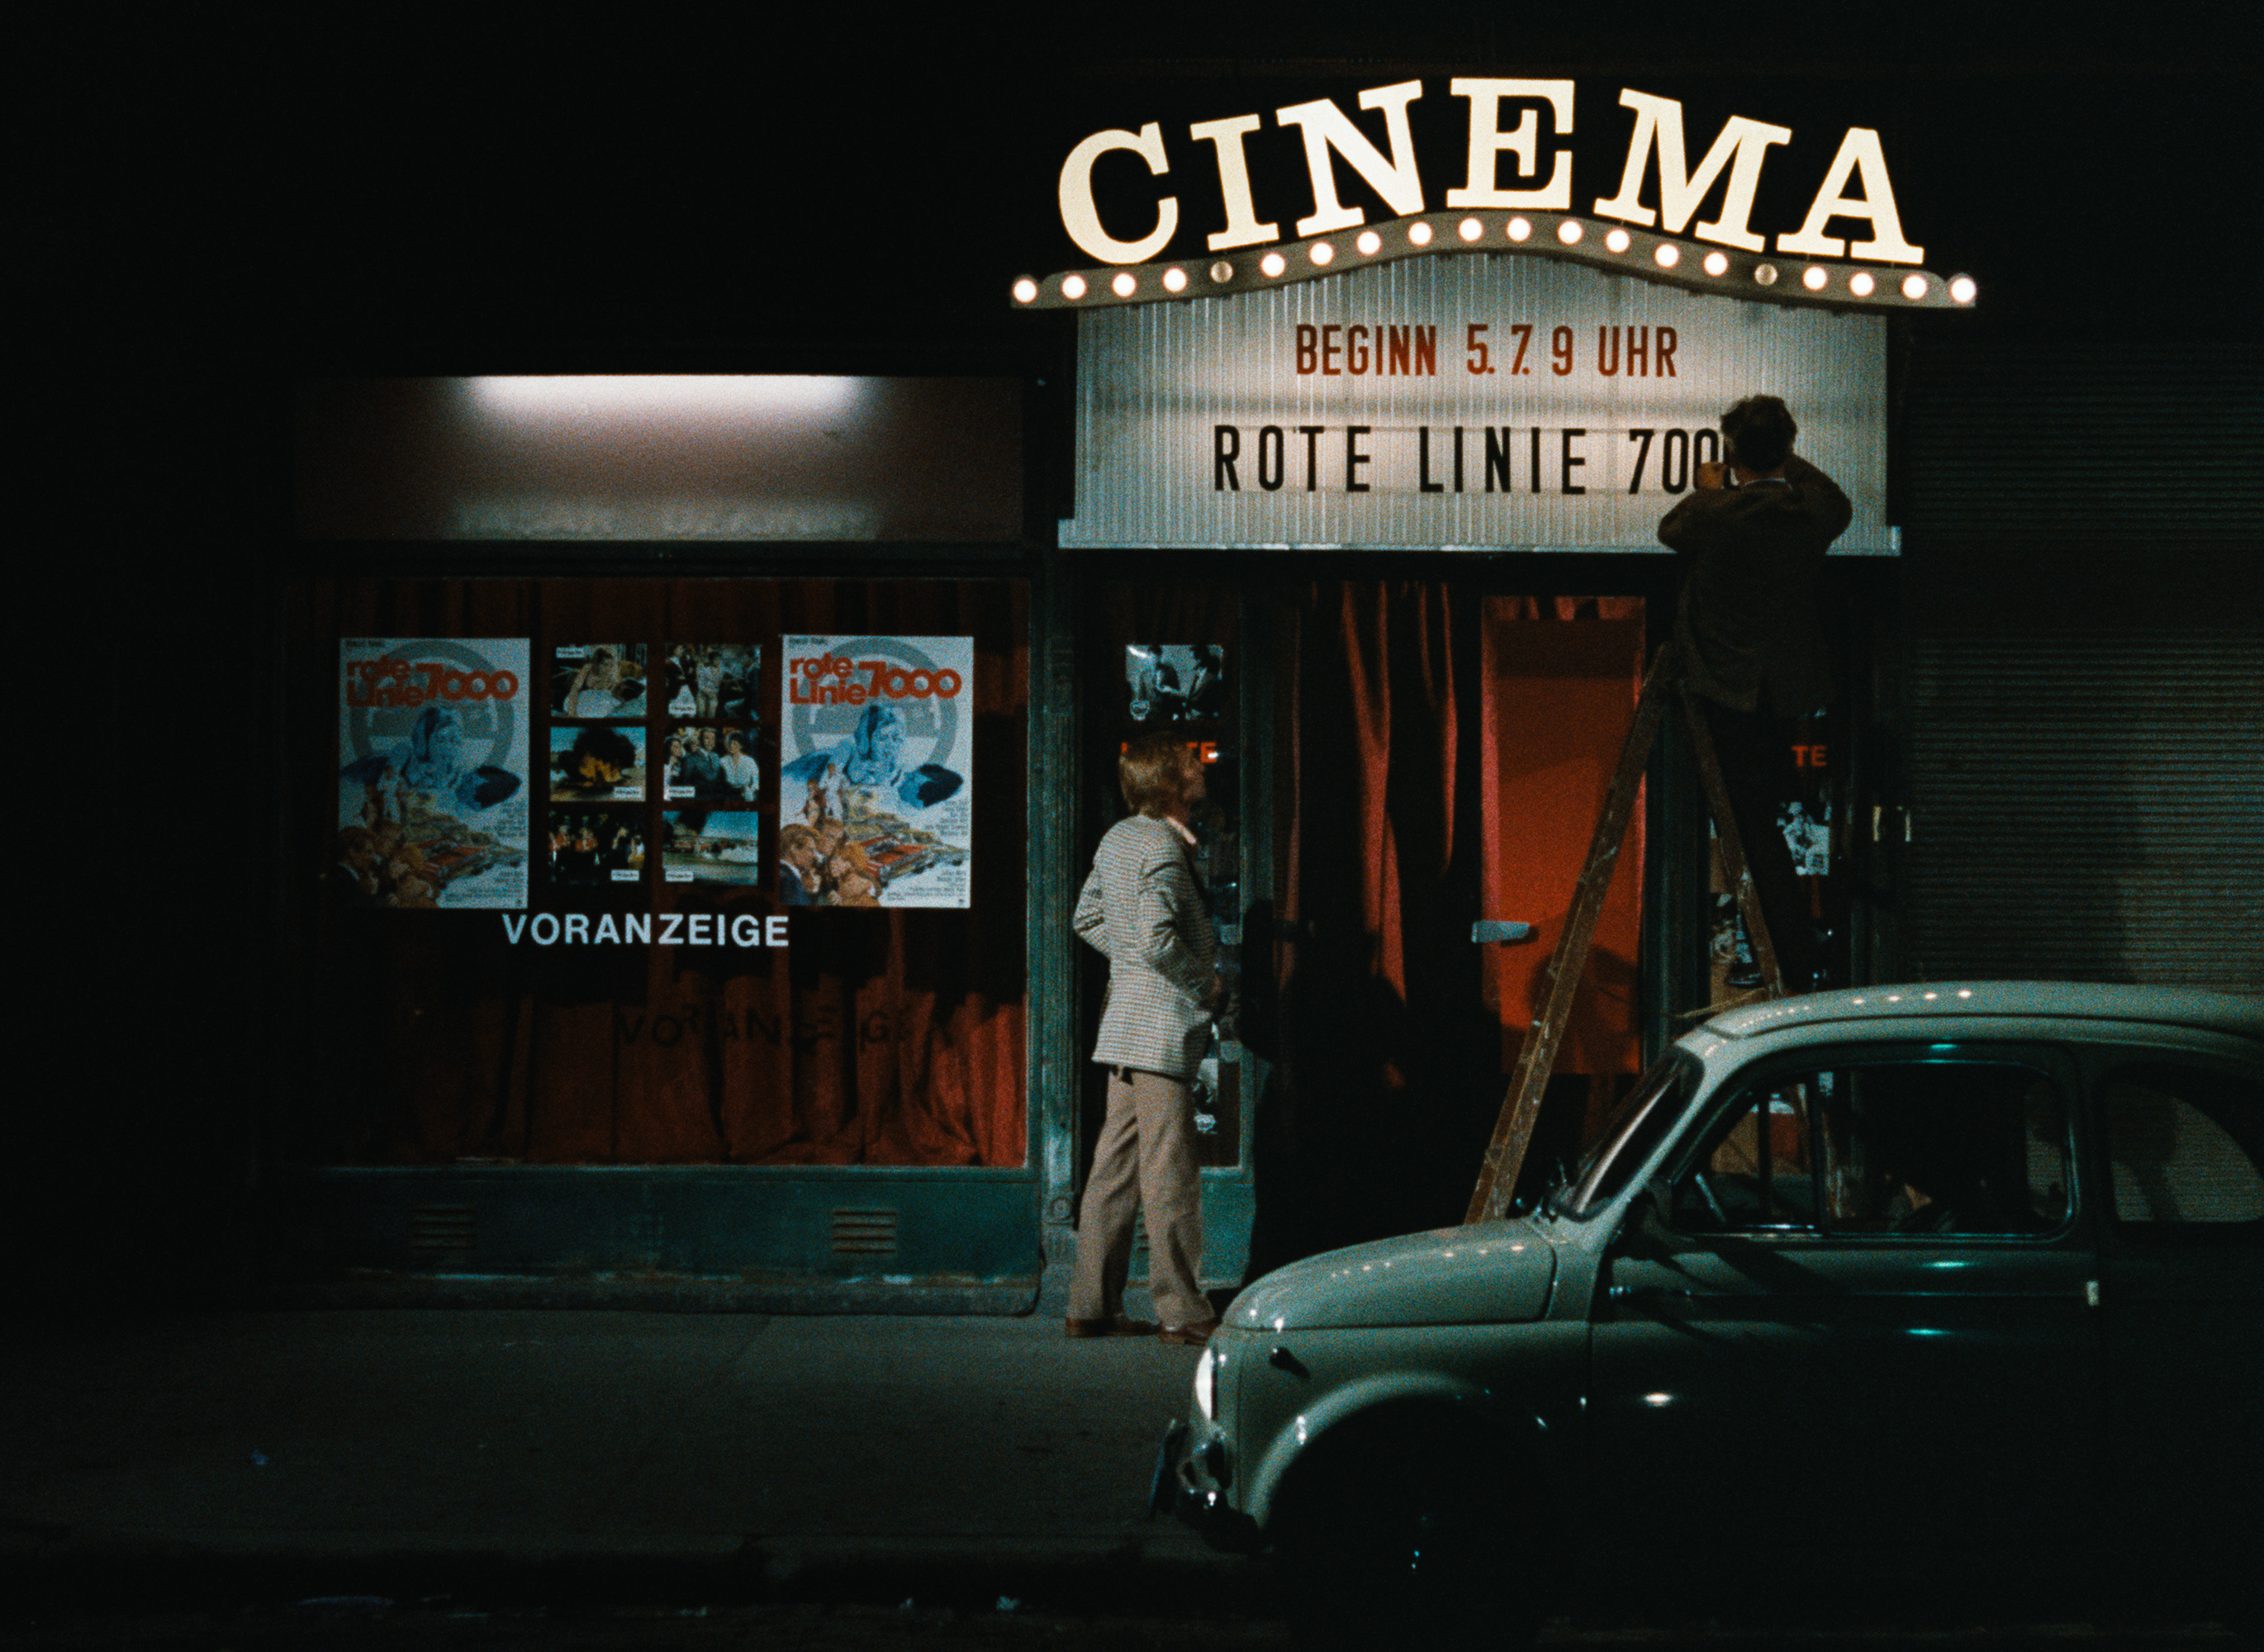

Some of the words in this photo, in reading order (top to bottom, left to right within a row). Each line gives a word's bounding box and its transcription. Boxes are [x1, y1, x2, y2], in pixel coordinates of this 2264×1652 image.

[1058, 78, 1926, 265] CINEMA
[1295, 322, 1437, 376] BEGINN
[1597, 326, 1678, 378] UHR
[1214, 427, 1370, 492] ROTE
[1420, 427, 1585, 493] LINIE
[346, 654, 411, 682] rote
[415, 663, 519, 701] 7000
[790, 653, 853, 678] rote
[858, 662, 961, 698] 7000
[347, 680, 425, 708] Linie
[790, 678, 866, 705] Linie
[502, 912, 790, 948] VORANZEIGE
